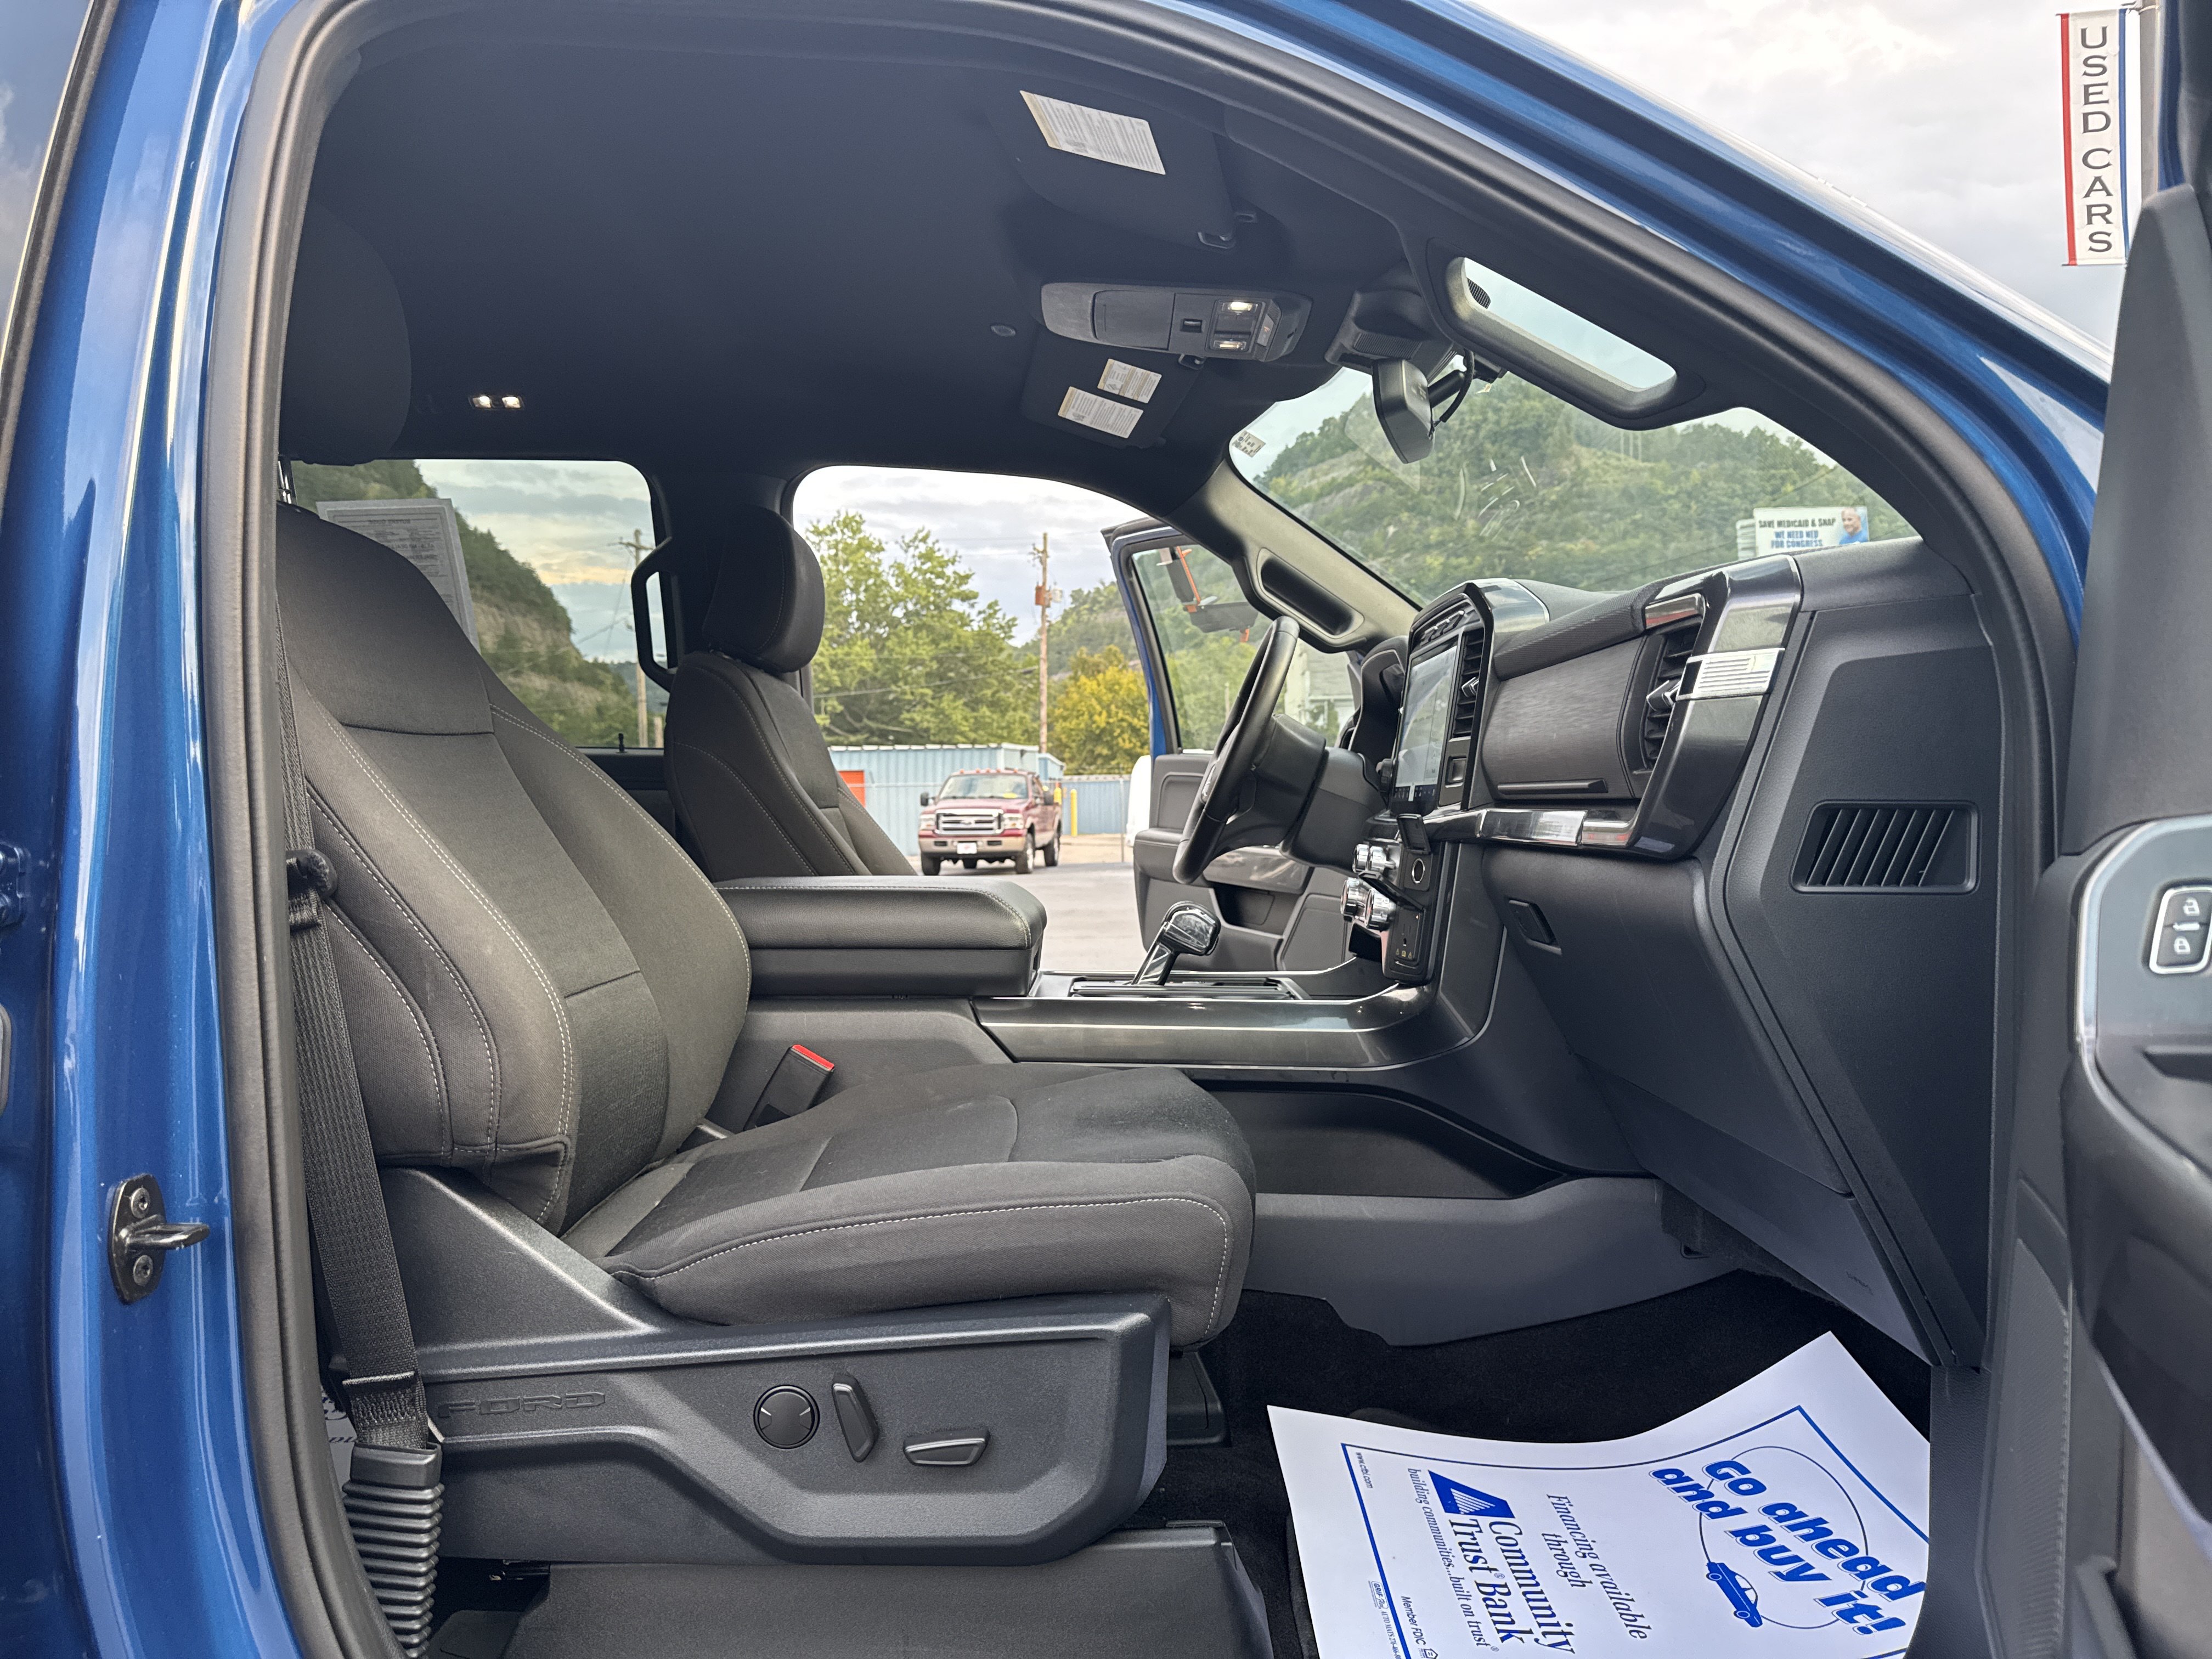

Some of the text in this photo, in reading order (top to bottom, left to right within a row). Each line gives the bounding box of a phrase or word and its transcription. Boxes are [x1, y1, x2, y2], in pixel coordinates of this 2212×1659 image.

[2080, 25, 2113, 252] USED CARS
[1758, 520, 1775, 528] SAVE
[1777, 518, 1809, 528] MEDICAID
[1786, 539, 1823, 548] CONGRESS
[438, 1391, 605, 1419] FORD
[1408, 1468, 1430, 1505] building
[1460, 1604, 1475, 1617] on
[1541, 1533, 1593, 1588] through
[1547, 1494, 1652, 1639] Financing available
[1649, 1468, 1906, 1636] and buy it!
[1702, 1460, 1927, 1602] Go ahead
[1401, 1595, 1418, 1627] Member
[1411, 1627, 1426, 1646] FDIC
[1474, 1580, 1534, 1644] Bank
[1488, 1521, 1576, 1654] Community
